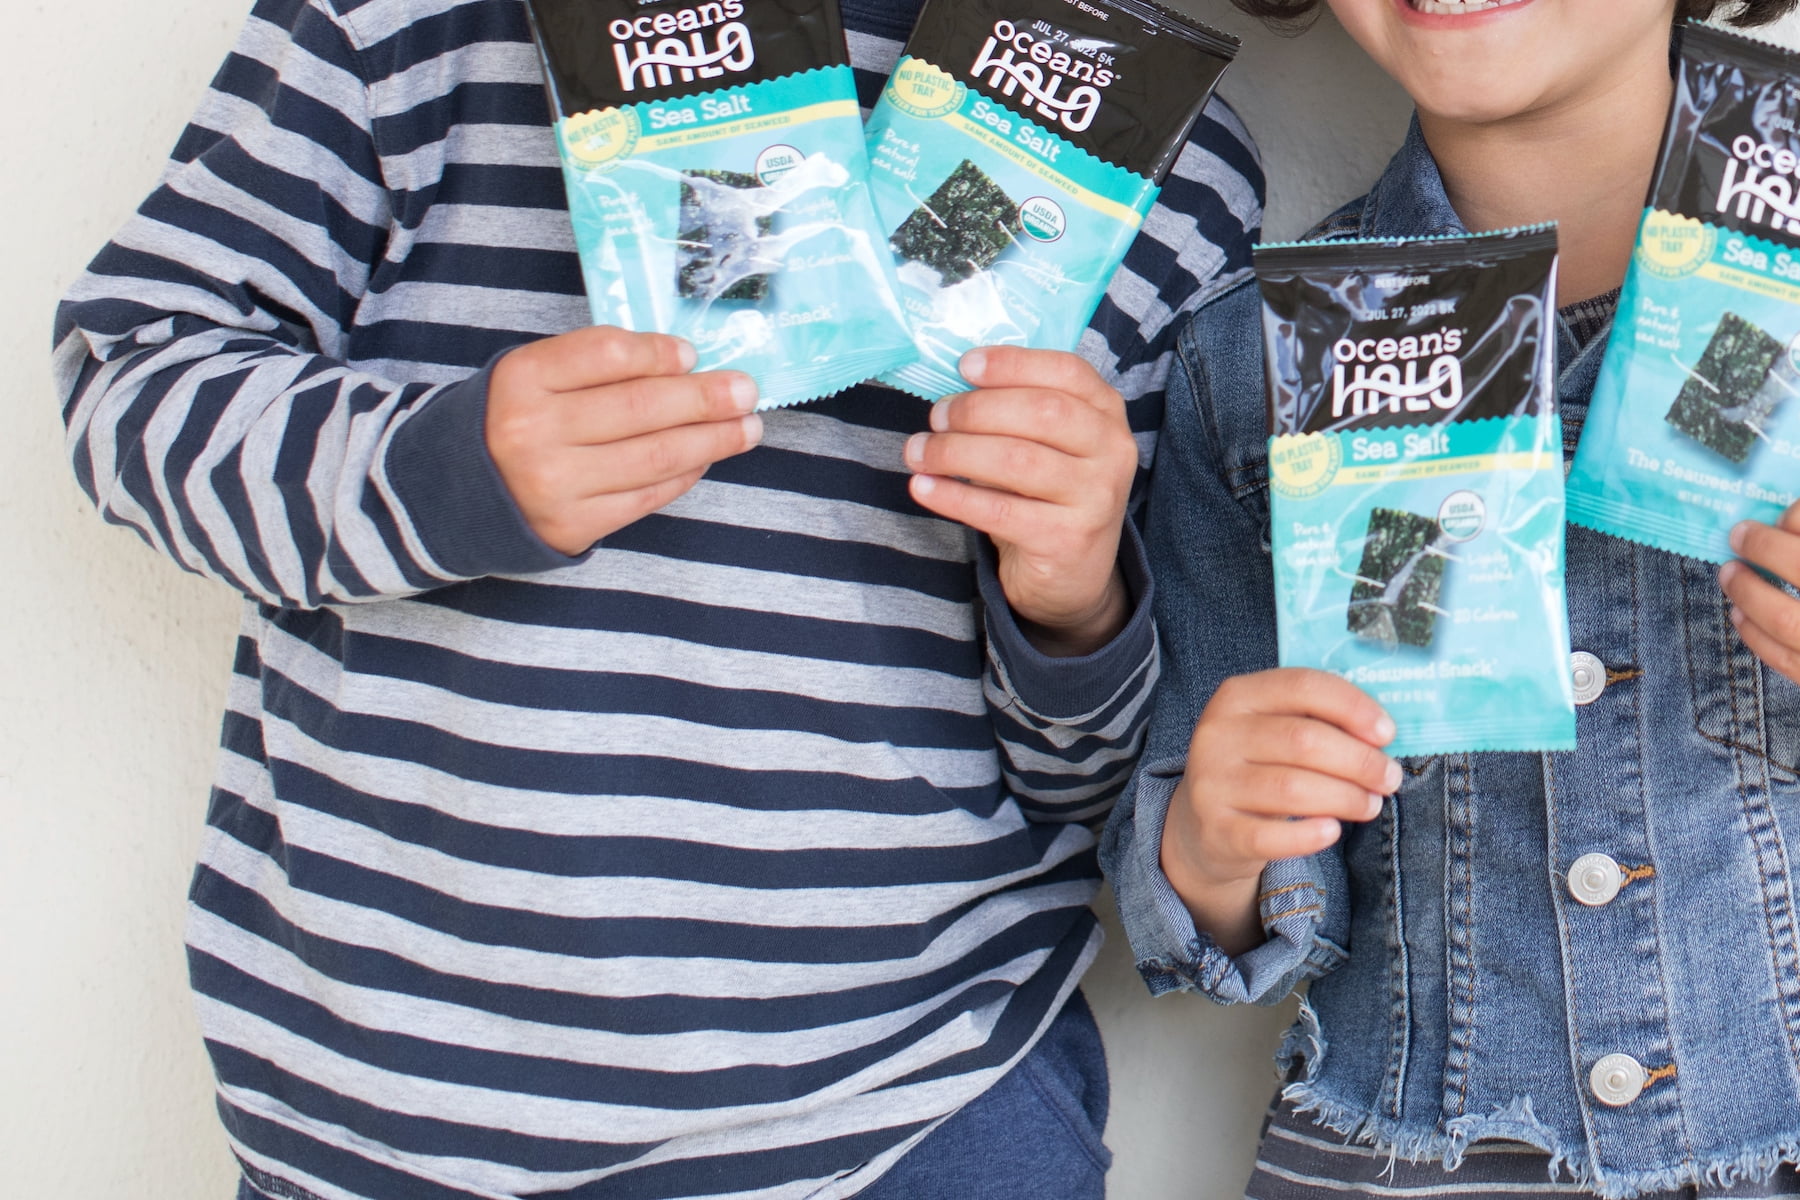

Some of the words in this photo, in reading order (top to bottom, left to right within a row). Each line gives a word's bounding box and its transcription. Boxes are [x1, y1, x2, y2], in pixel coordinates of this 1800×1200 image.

[1077, 1, 1110, 22] BEFORE
[993, 19, 1115, 88] ocean's
[1032, 19, 1053, 37] JUL
[1053, 29, 1071, 46] 27,
[1097, 50, 1116, 67] SK
[611, 20, 756, 92] HALO
[899, 70, 912, 81] NO
[913, 71, 952, 91] PLASTIC
[912, 83, 936, 97] TRAY
[969, 35, 1102, 133] HALO
[649, 105, 697, 130] Sea
[700, 93, 753, 120] Salt
[745, 115, 791, 130] SEAWEED
[884, 128, 910, 149] Pure
[969, 99, 1012, 134] Sea
[1015, 124, 1062, 163] Salt
[765, 155, 795, 168] USDA
[877, 144, 920, 168] natural
[963, 122, 988, 141] SAME
[989, 137, 1025, 163] AMOUNT
[1025, 159, 1038, 169] OF
[1038, 167, 1079, 195] SEAWEED
[872, 157, 892, 171] sea
[893, 167, 918, 181] salt
[1023, 213, 1057, 237] ORGANIC
[1032, 204, 1058, 224] USDA
[1660, 225, 1699, 239] PLASTIC
[1722, 238, 1768, 271] Sea
[778, 305, 833, 328] Snack
[1367, 308, 1389, 321] JUL
[1391, 306, 1408, 319] 27,
[1410, 303, 1437, 317] 2022
[1333, 326, 1462, 362] ocean's
[1331, 354, 1464, 418] HALO
[1352, 436, 1399, 461] Sea
[1403, 432, 1451, 458] Salt
[1627, 447, 1660, 472] The
[1662, 458, 1742, 495] Seaweed
[1448, 503, 1475, 514] USDA
[1355, 661, 1436, 683] Seaweed
[1438, 658, 1493, 678] Snack
